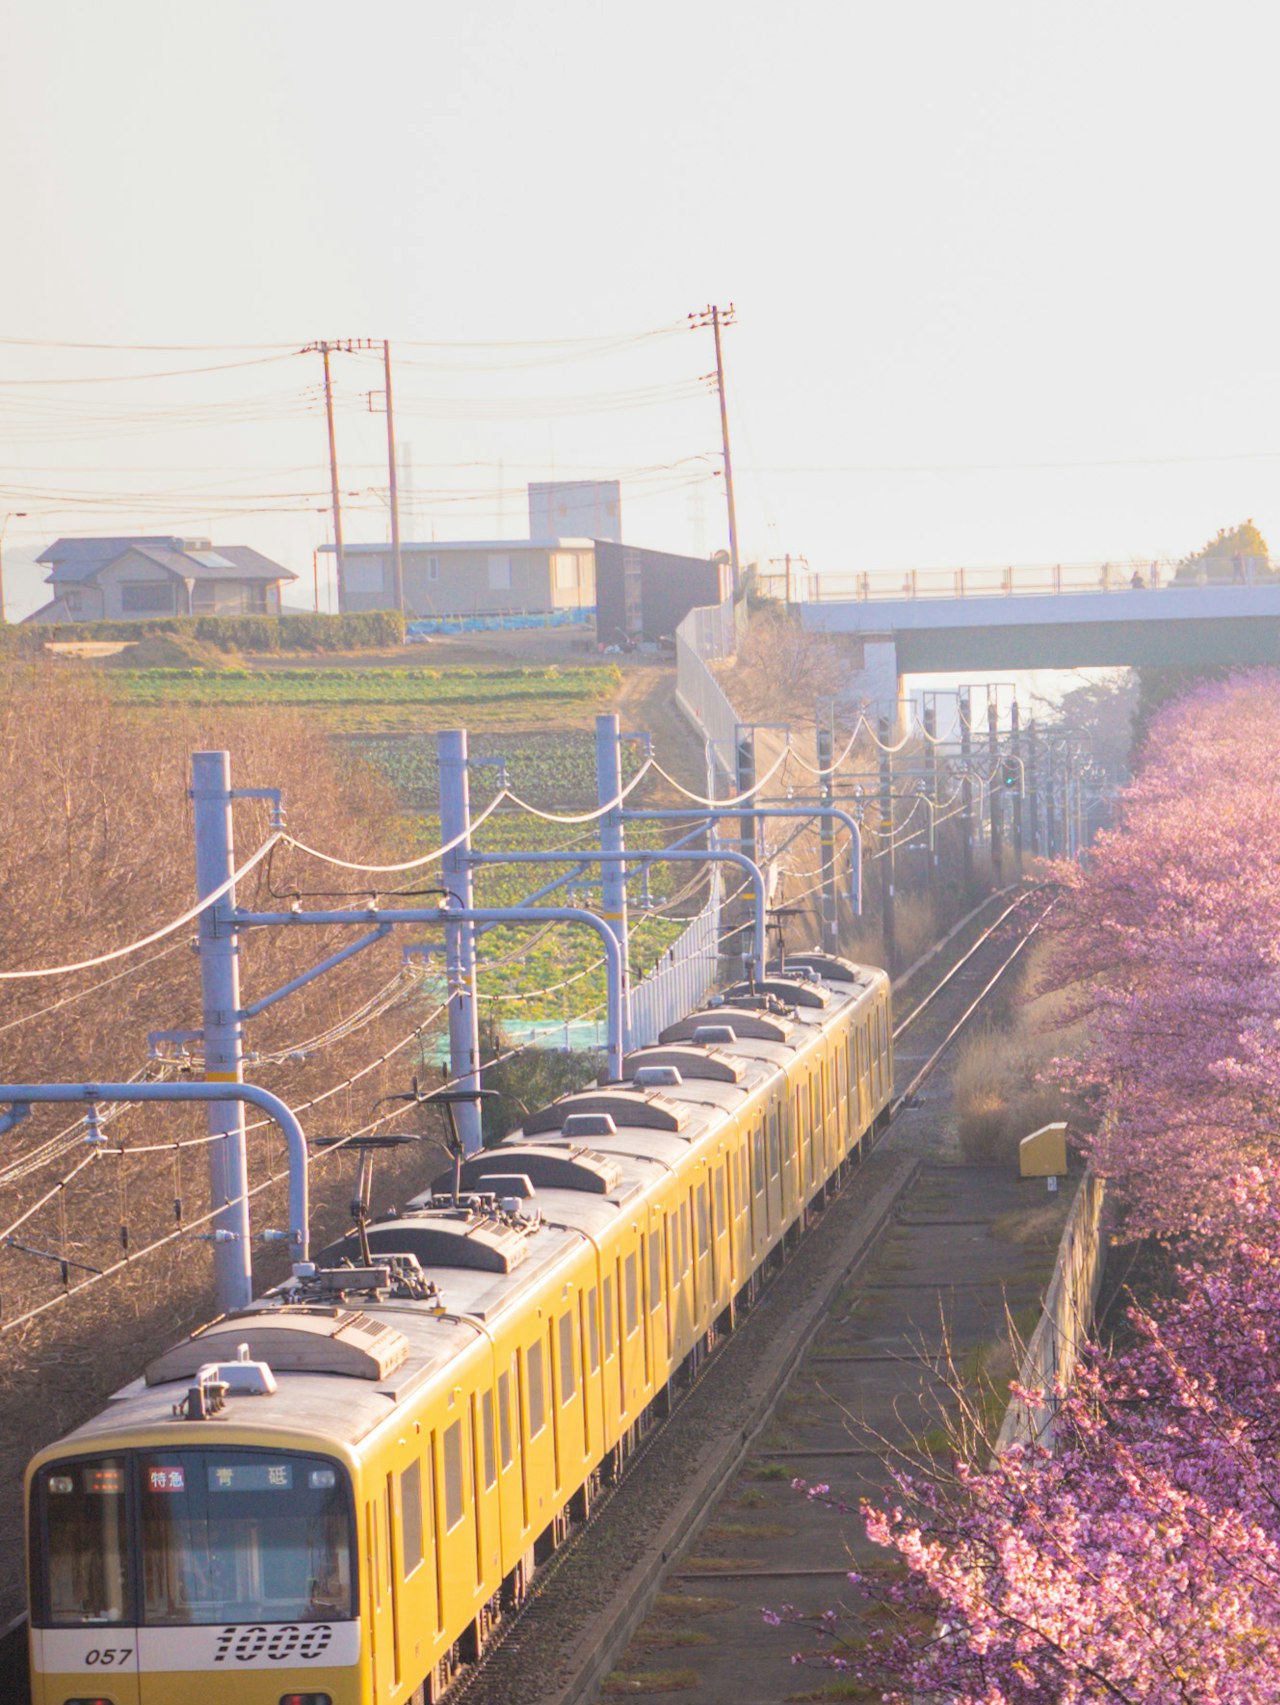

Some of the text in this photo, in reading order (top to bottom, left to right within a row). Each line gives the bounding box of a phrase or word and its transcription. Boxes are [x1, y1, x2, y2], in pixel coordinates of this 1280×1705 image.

[151, 1470, 184, 1488] 特急
[214, 1625, 332, 1661] 1000
[85, 1649, 133, 1665] 057
